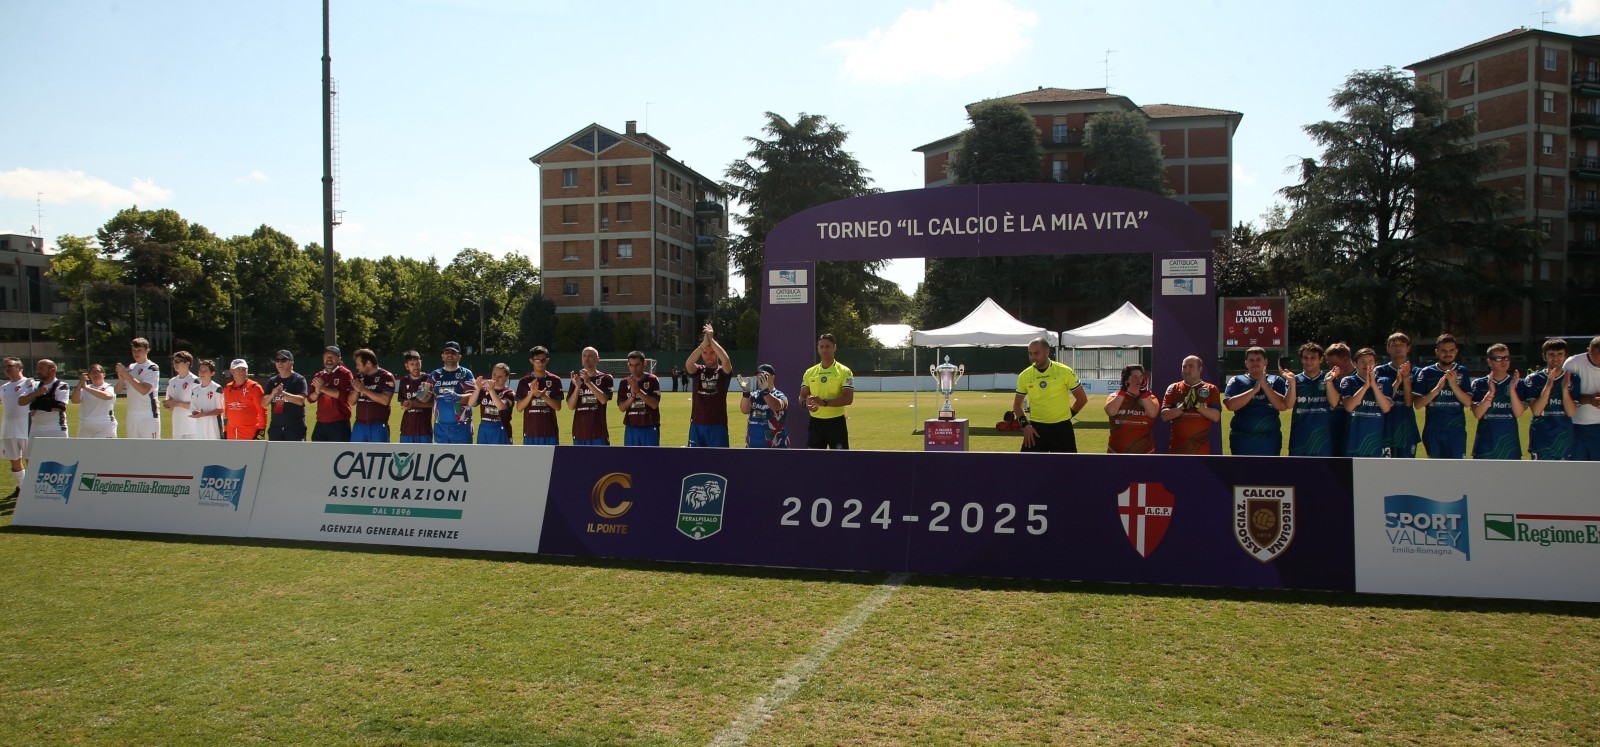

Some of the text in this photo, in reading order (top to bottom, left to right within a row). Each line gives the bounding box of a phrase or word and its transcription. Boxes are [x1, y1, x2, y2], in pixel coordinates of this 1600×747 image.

[817, 220, 892, 239] TORNEO
[928, 216, 998, 236] CALCIO
[1003, 211, 1015, 233] È
[1020, 214, 1046, 232] LA
[1051, 212, 1088, 231] MIA
[1235, 316, 1273, 324] LA MIA VITA
[333, 450, 470, 483] CATTOLICA
[36, 472, 73, 484] SPORT
[199, 477, 241, 490] SPORT
[34, 484, 71, 495] VALLEY
[198, 489, 238, 502] VALLEY
[328, 485, 468, 502] ASSICURAZIONI
[1242, 488, 1286, 498] CALCIO
[372, 507, 411, 516] DAL 1896
[1146, 507, 1170, 515] A.C.P.
[1385, 512, 1461, 530] SPORT
[320, 524, 459, 539] AGENZIA GENERALE FIRENZE
[587, 523, 628, 534] IL PONTE
[1267, 502, 1292, 555] REGGIANA
[1385, 529, 1463, 547] VALLEY
